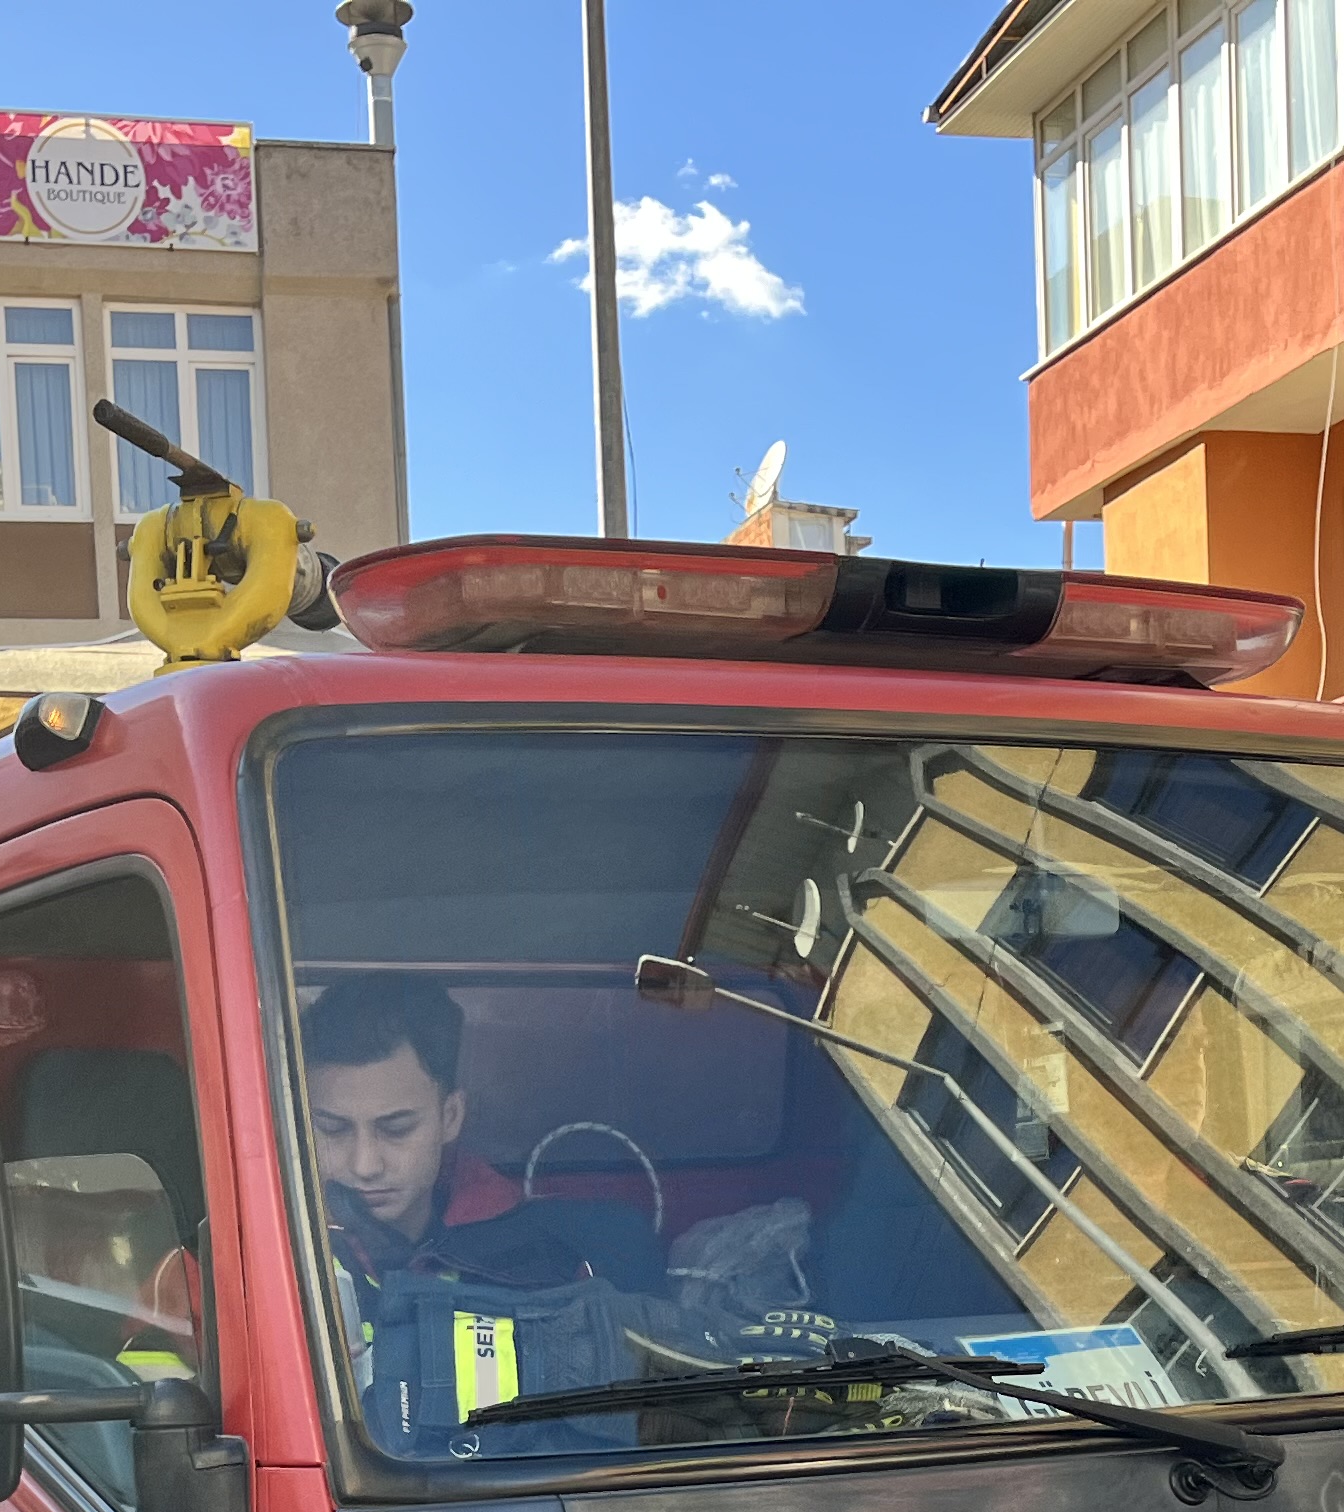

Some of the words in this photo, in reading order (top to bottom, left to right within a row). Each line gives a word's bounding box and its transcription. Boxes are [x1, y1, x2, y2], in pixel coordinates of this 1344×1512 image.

[29, 159, 142, 188] HANDE
[46, 188, 127, 204] BOUTIQUE
[467, 1316, 495, 1358] SEİ
